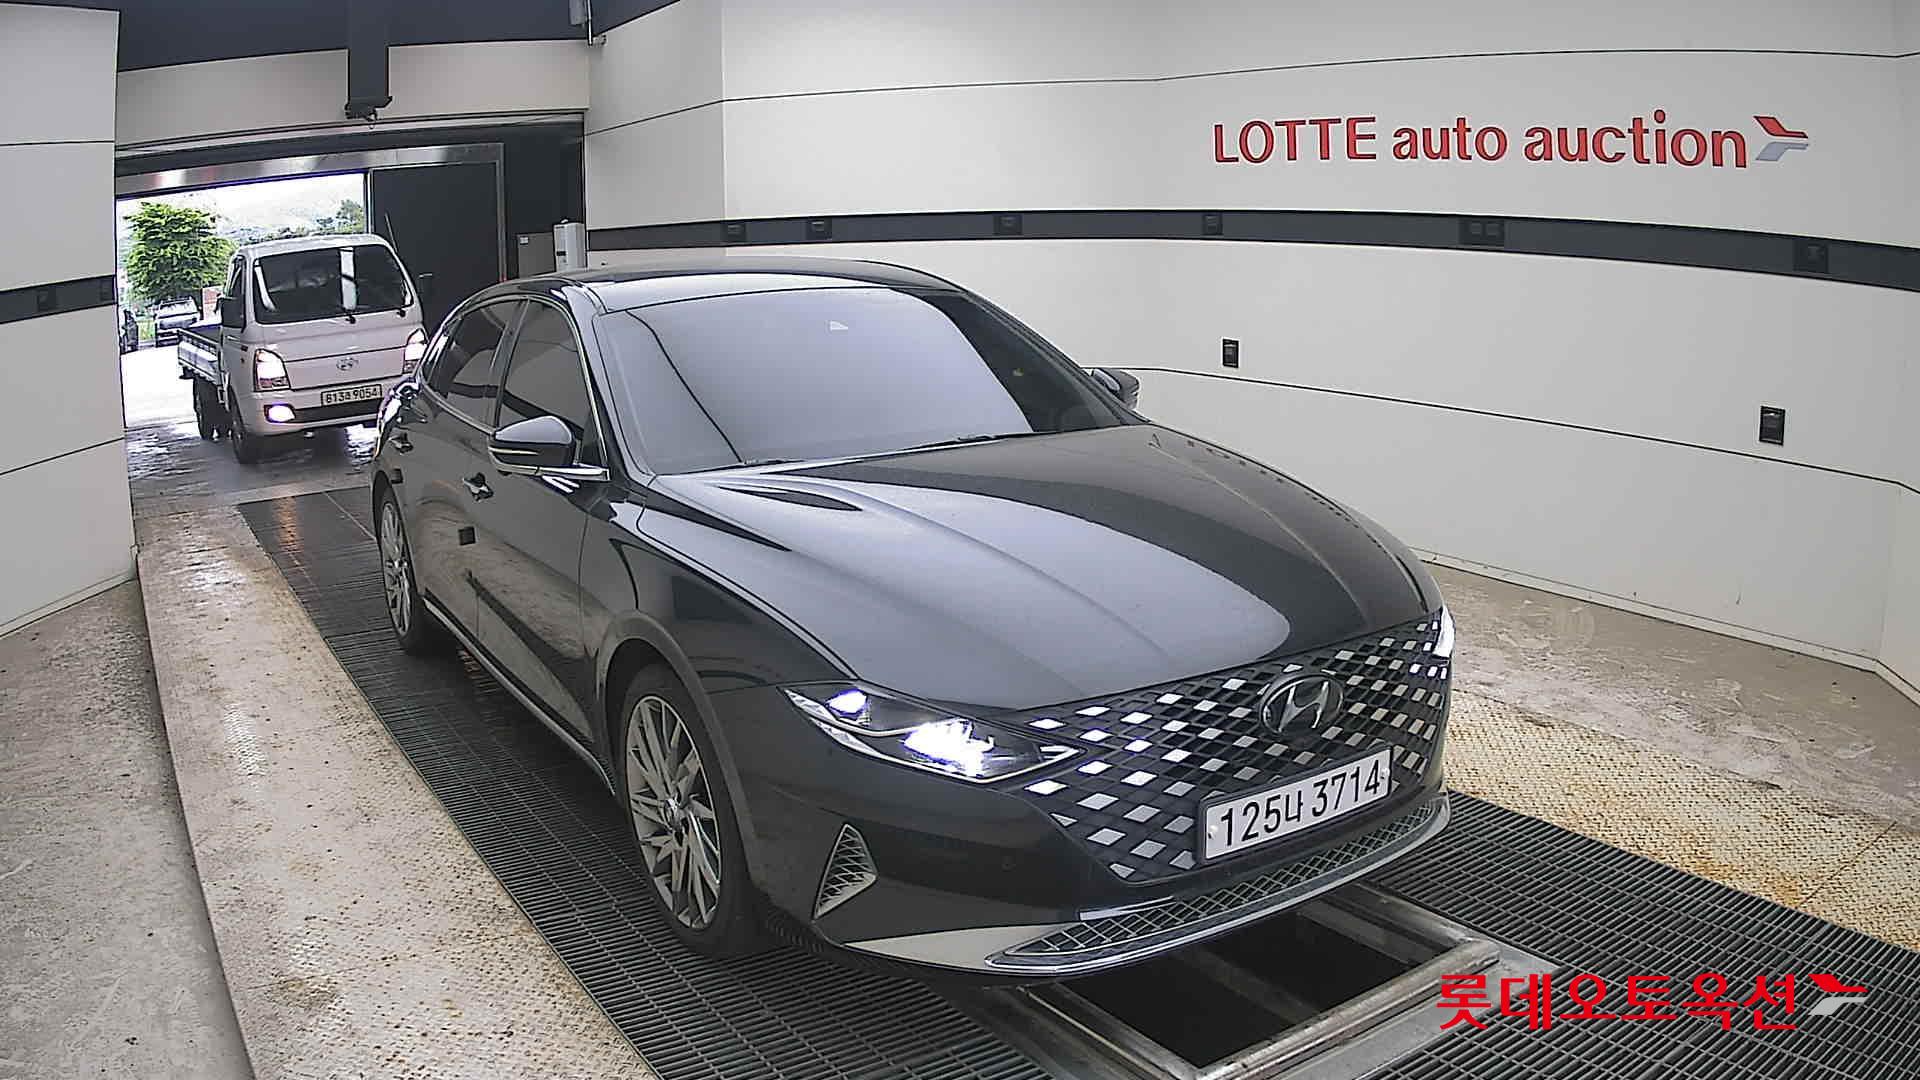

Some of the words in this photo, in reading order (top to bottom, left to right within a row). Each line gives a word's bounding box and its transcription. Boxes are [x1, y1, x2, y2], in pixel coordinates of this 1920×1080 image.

[1213, 115, 1377, 164] LOTTE
[1391, 116, 1508, 162] auto
[1523, 109, 1748, 169] auction
[352, 387, 378, 400] 9054
[1220, 790, 1304, 846] 125나
[1311, 759, 1380, 817] 3714
